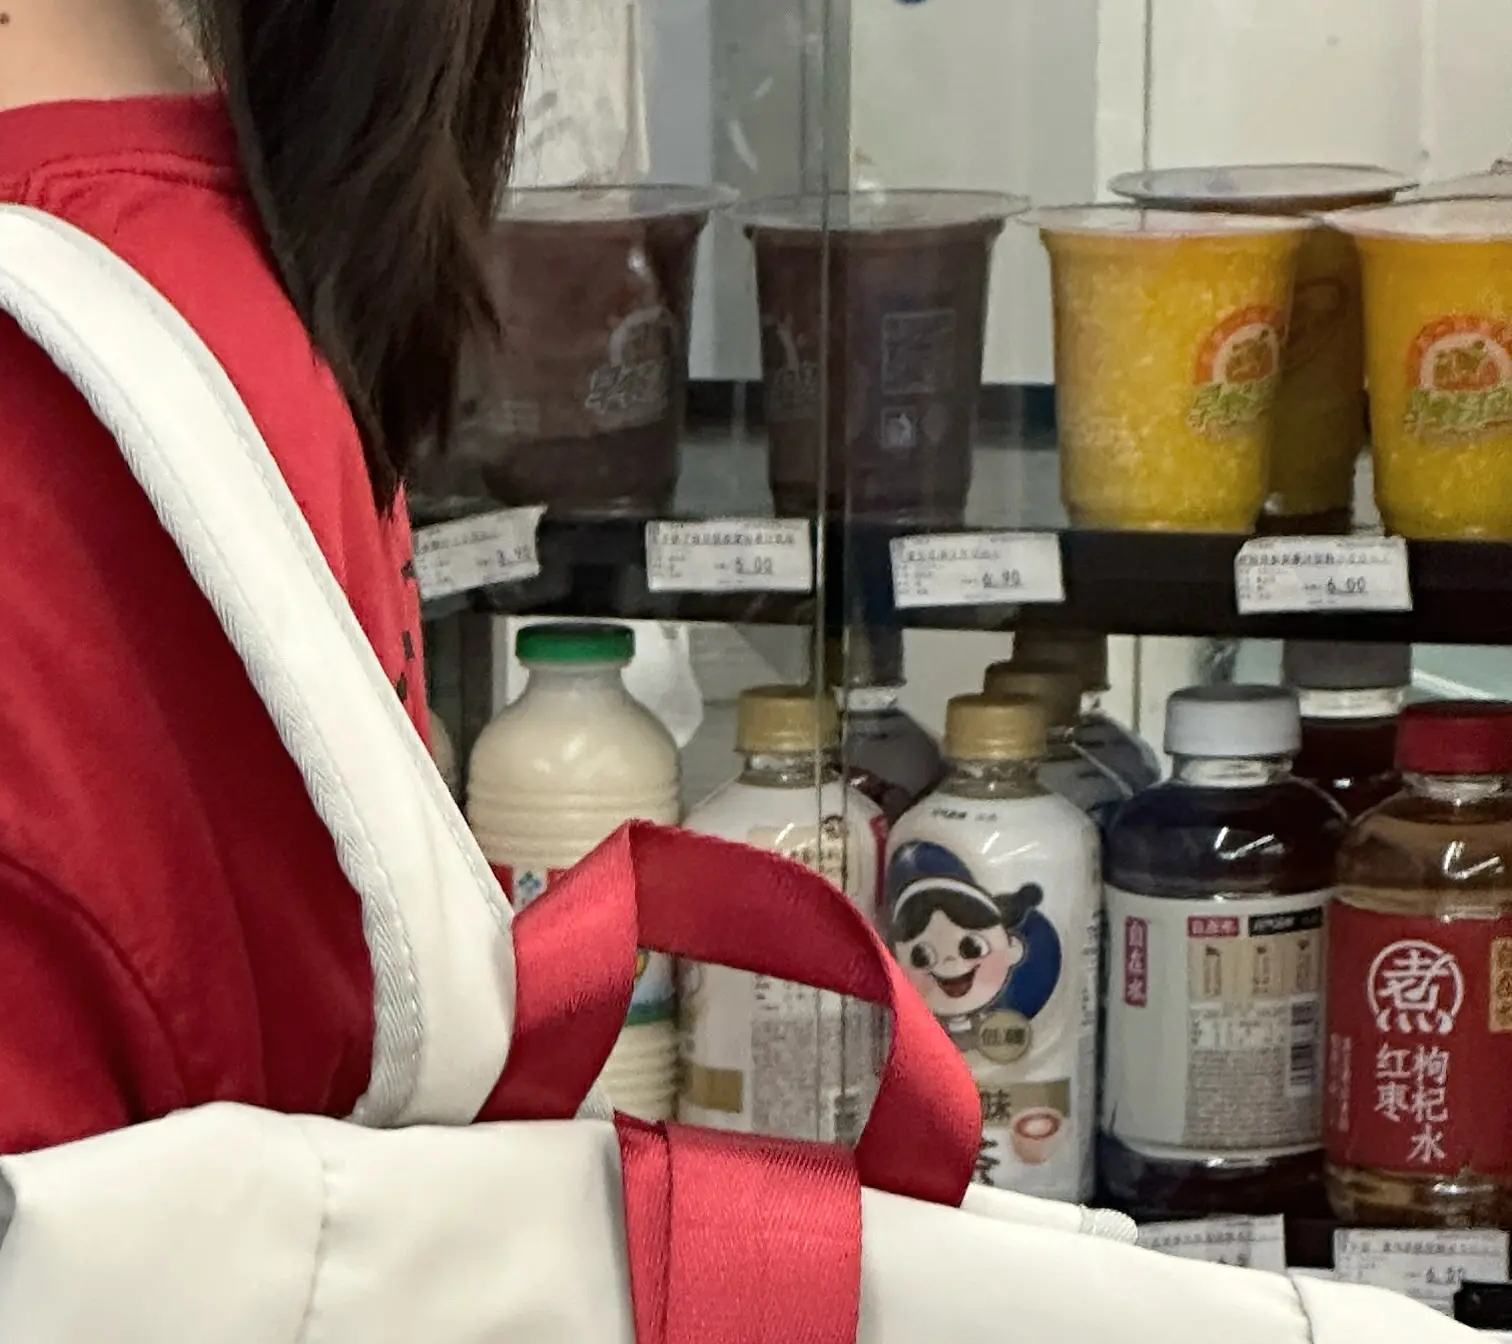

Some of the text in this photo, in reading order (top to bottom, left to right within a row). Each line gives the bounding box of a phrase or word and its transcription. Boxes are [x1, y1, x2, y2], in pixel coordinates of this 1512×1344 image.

[1376, 947, 1456, 1035] 煮
[1374, 1043, 1411, 1122] 红枣
[1407, 1044, 1449, 1164] 枸杞水
